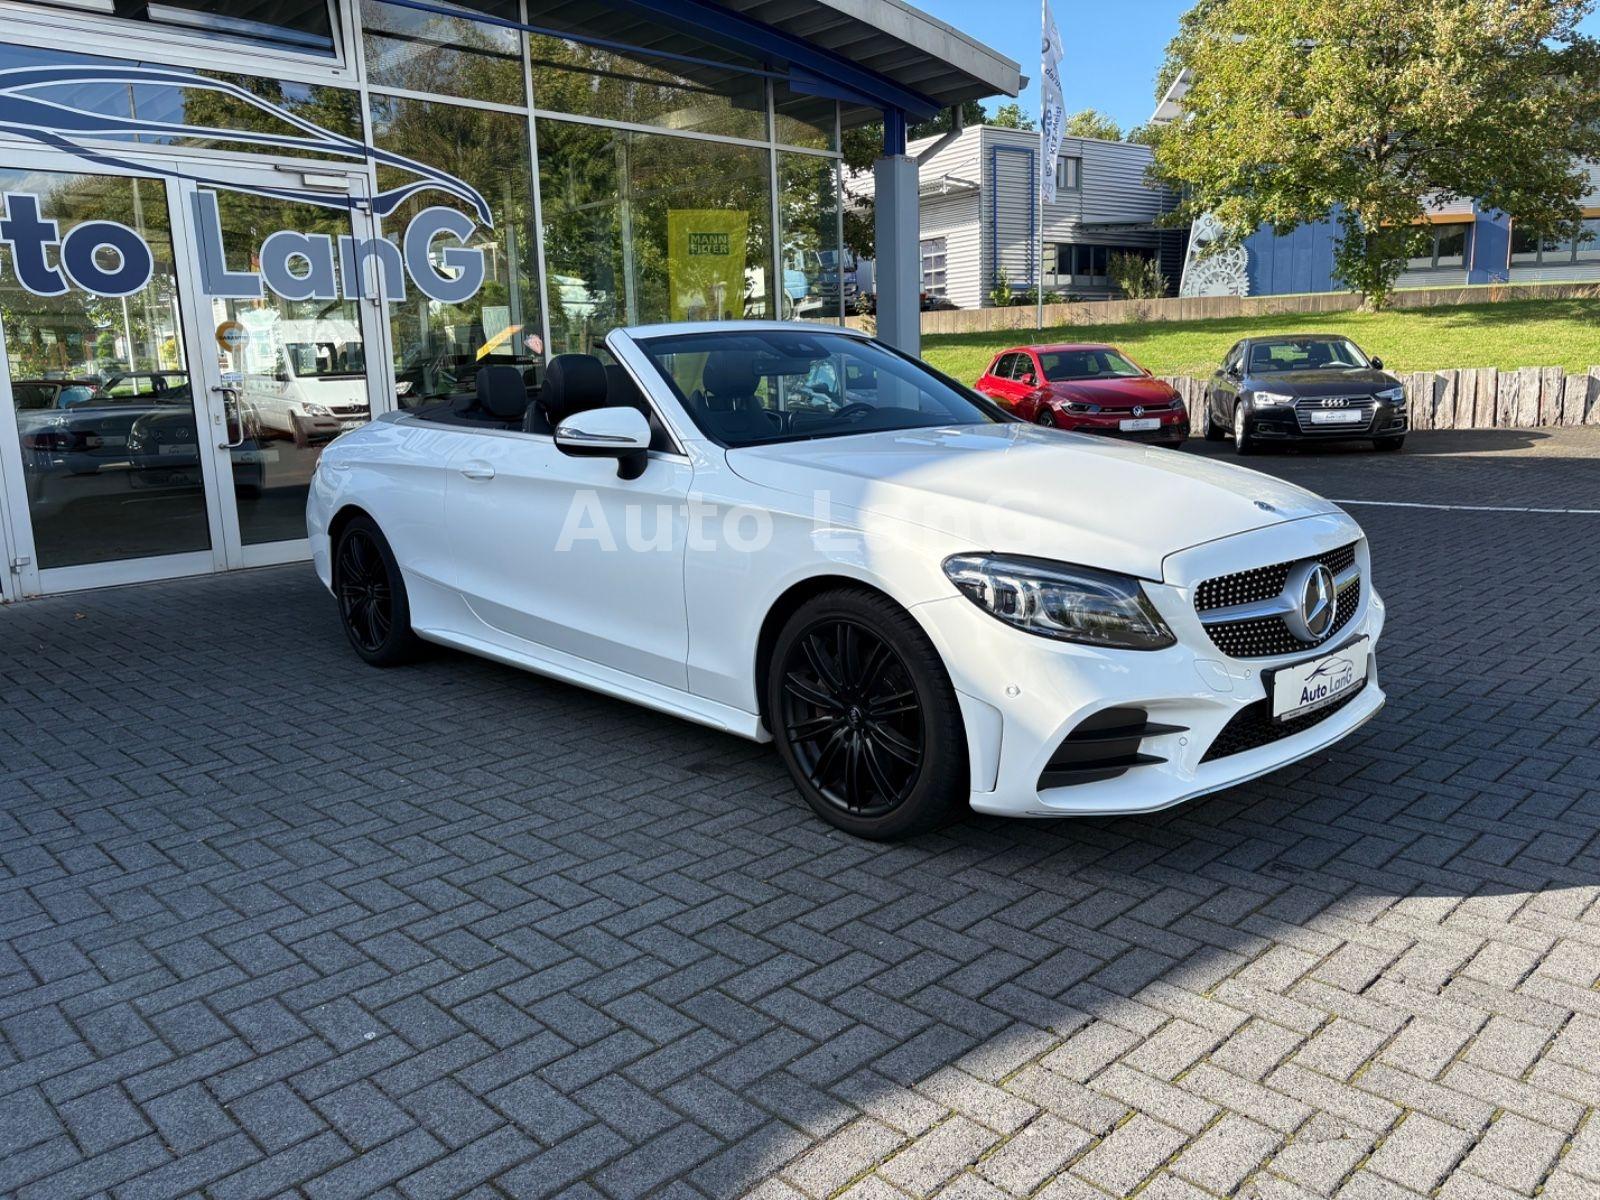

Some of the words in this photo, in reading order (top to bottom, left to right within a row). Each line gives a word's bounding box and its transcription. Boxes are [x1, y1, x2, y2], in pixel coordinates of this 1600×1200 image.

[0, 192, 154, 298] to
[190, 190, 486, 304] LanG
[690, 234, 728, 244] MANN
[690, 244, 728, 254] FILTER
[1300, 684, 1328, 705] Auto
[1330, 667, 1353, 693] LanG
